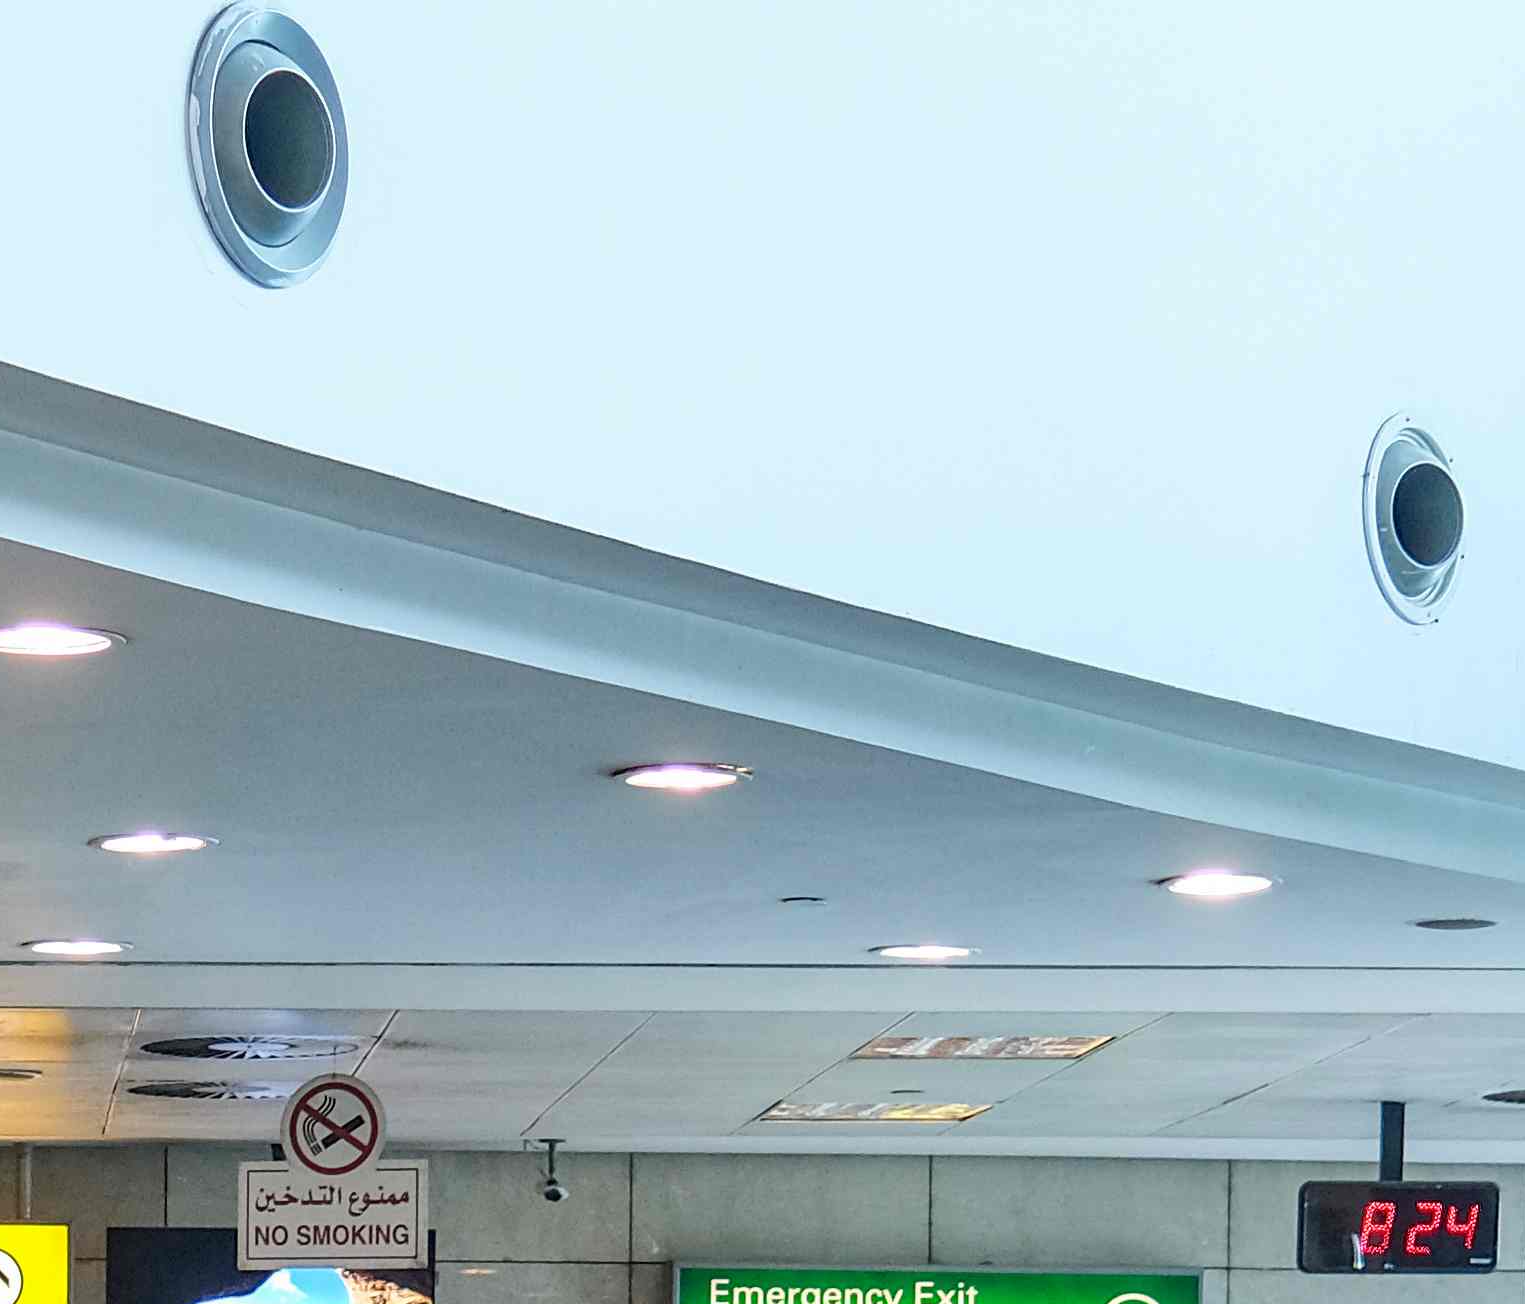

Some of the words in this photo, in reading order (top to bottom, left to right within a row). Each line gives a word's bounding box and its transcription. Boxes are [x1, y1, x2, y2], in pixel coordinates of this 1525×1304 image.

[254, 1185, 342, 1213] التدخين
[347, 1186, 410, 1217] ممنوع
[254, 1225, 289, 1246] NO
[296, 1224, 410, 1246] SMOKING
